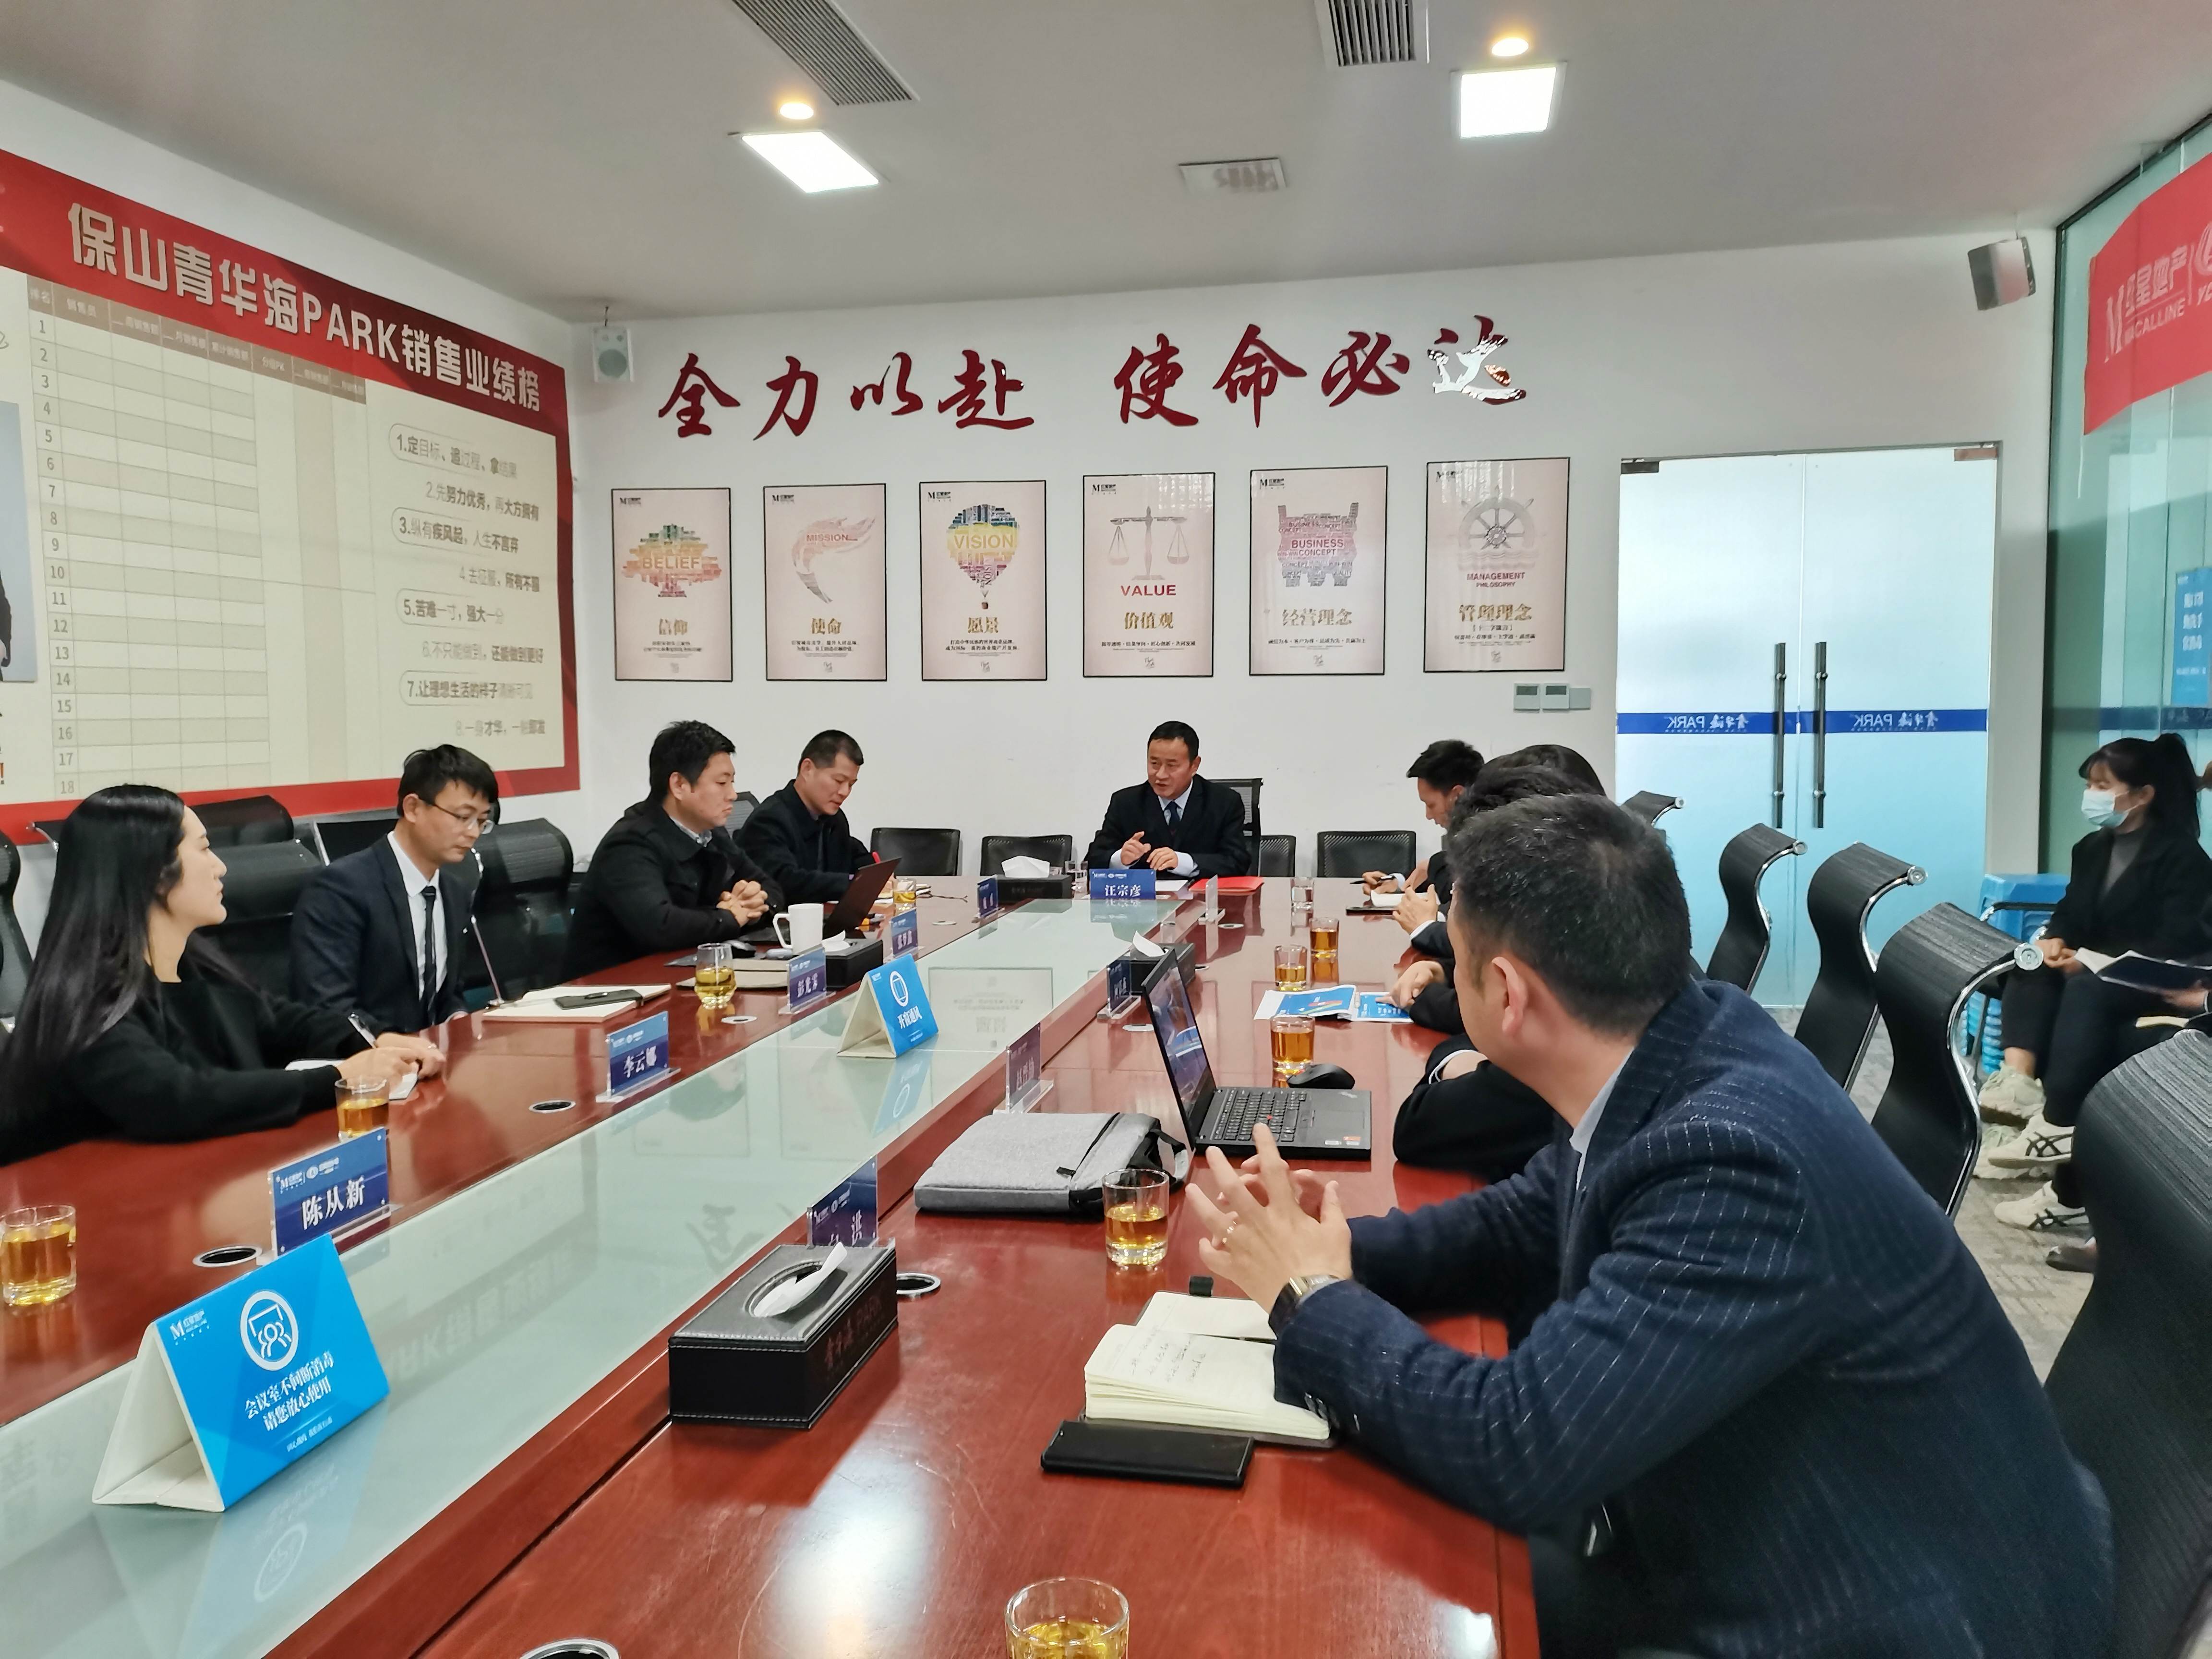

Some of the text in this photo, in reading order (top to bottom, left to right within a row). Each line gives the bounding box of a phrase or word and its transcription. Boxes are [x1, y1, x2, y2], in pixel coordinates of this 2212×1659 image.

[68, 203, 541, 412] 保山青华海PARK销售业绩榜
[39, 320, 46, 334] 1
[40, 348, 48, 362] 2
[42, 375, 49, 388] 3
[658, 315, 1527, 441] 全力以赴 使命必达
[43, 401, 51, 415] 4
[45, 429, 53, 443] 5
[47, 457, 55, 470] 6
[49, 485, 56, 498] 7
[50, 512, 58, 525] 8
[806, 533, 849, 542] MISSION
[954, 534, 1013, 549] VISION
[1292, 539, 1344, 549] BUSINESS
[51, 538, 59, 552] 9
[642, 557, 702, 569] BELIEF
[50, 566, 65, 579] 10
[1467, 572, 1526, 581] MANAGEMENT
[1120, 584, 1177, 597] VALUE
[52, 592, 66, 606] 11
[1282, 608, 1352, 626] 经营理念
[1459, 603, 1532, 622] 管理理念
[53, 620, 68, 633] 12
[811, 618, 842, 635] 使命
[967, 616, 999, 634] 愿景
[1124, 612, 1174, 630] 价值观
[55, 647, 70, 660] 13
[56, 673, 71, 686] 14
[57, 699, 72, 713] 15
[58, 727, 73, 740] 16
[59, 753, 73, 766] 17
[60, 781, 74, 794] 18
[1105, 884, 1141, 897] 汪宗彦
[301, 1175, 365, 1231] 陈从新
[245, 1350, 334, 1419] 会议室不间断消毒
[262, 1374, 332, 1431] 请您放心使用
